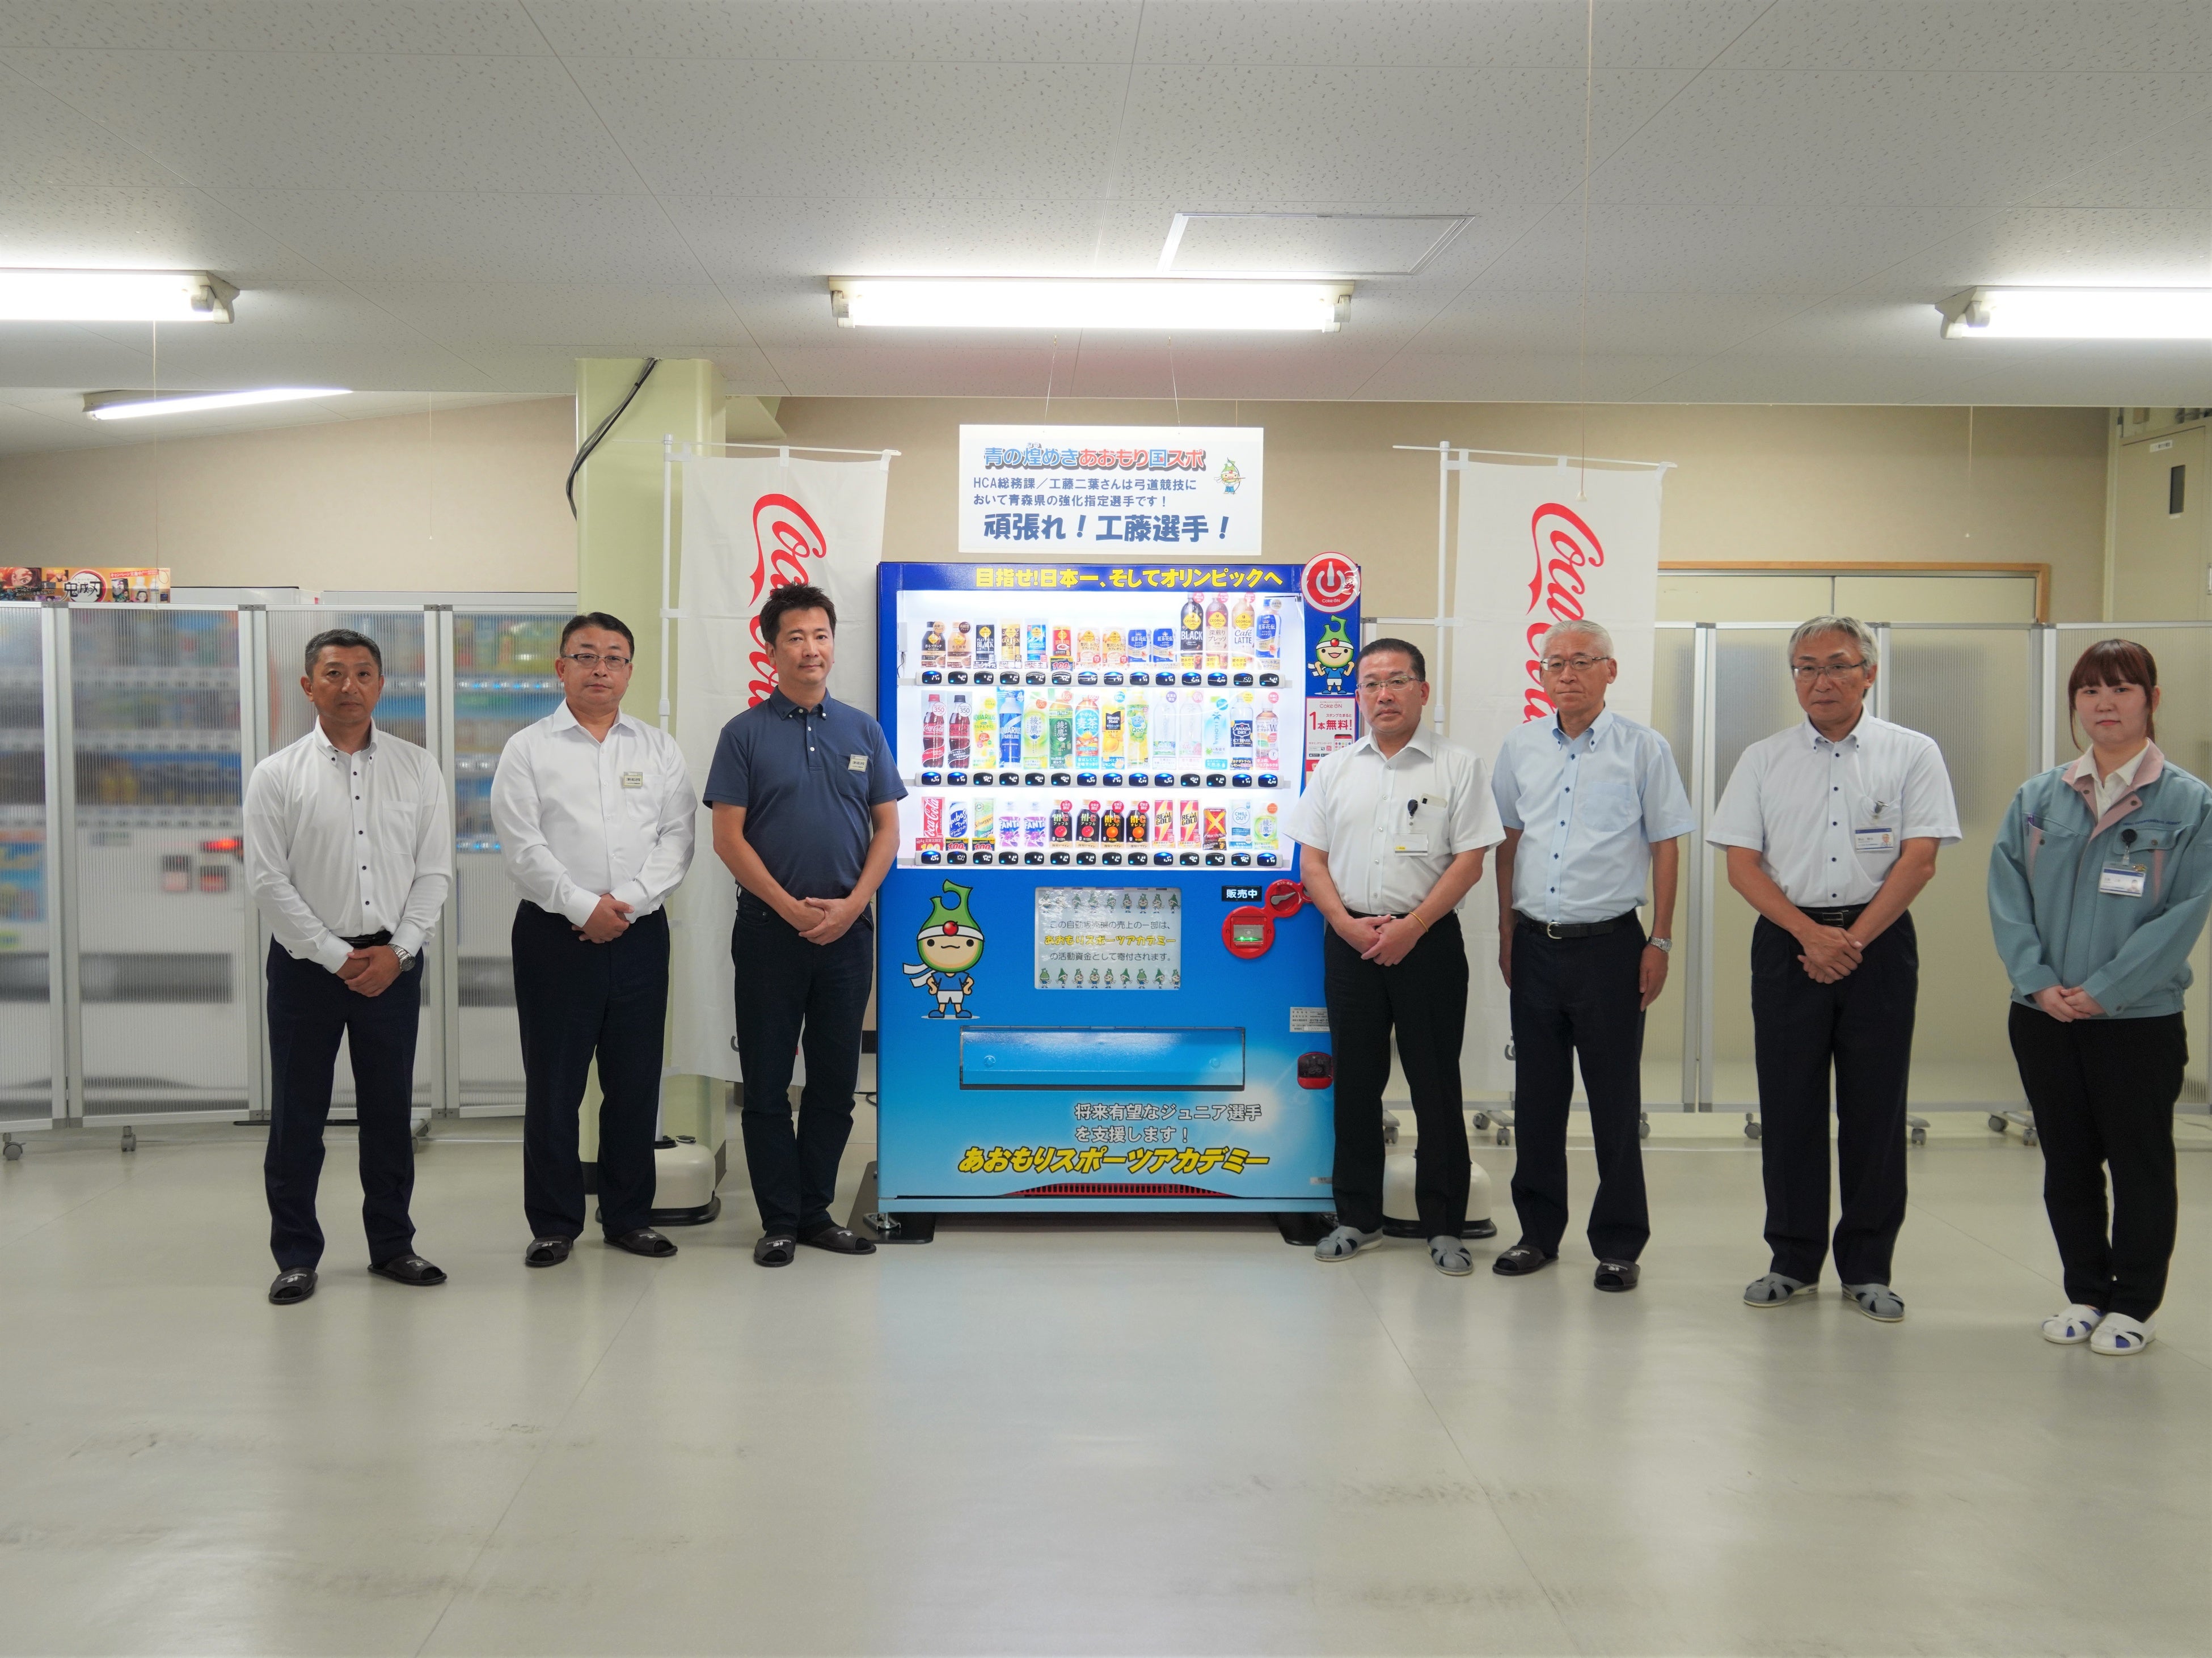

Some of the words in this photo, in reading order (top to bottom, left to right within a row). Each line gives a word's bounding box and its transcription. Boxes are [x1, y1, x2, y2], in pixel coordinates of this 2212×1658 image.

[984, 447, 1206, 471] 青の煌めきあおもり国スポ
[973, 494, 1167, 507] おいて青森県の強化指定選手です!
[984, 513, 1229, 543] 頑張れ!工藤選手!
[976, 568, 1284, 589] 目指せ!日本一、そしてオリンピックへ
[64, 581, 104, 599] 鬼滅の刃
[1181, 631, 1202, 640] BLACK
[1029, 716, 1039, 734] 綾鷹
[1077, 717, 1097, 729] 麦茶
[1309, 711, 1352, 730] 1本無料!
[1057, 721, 1063, 737] 綾鷹
[1263, 819, 1269, 832] 綾鷹
[1226, 889, 1258, 899] 販売中
[1050, 921, 1171, 930] この自動販売機の売上の一部は、
[1044, 935, 1176, 946] あおもりスポーツアカデミー
[1050, 953, 1171, 962] の活動資金として寄付されます。
[1074, 1103, 1262, 1122] 将来有望なジュニア選手
[1075, 1126, 1189, 1143] を支援します!
[958, 1145, 1270, 1174] あおもりスポーツアカデミー
